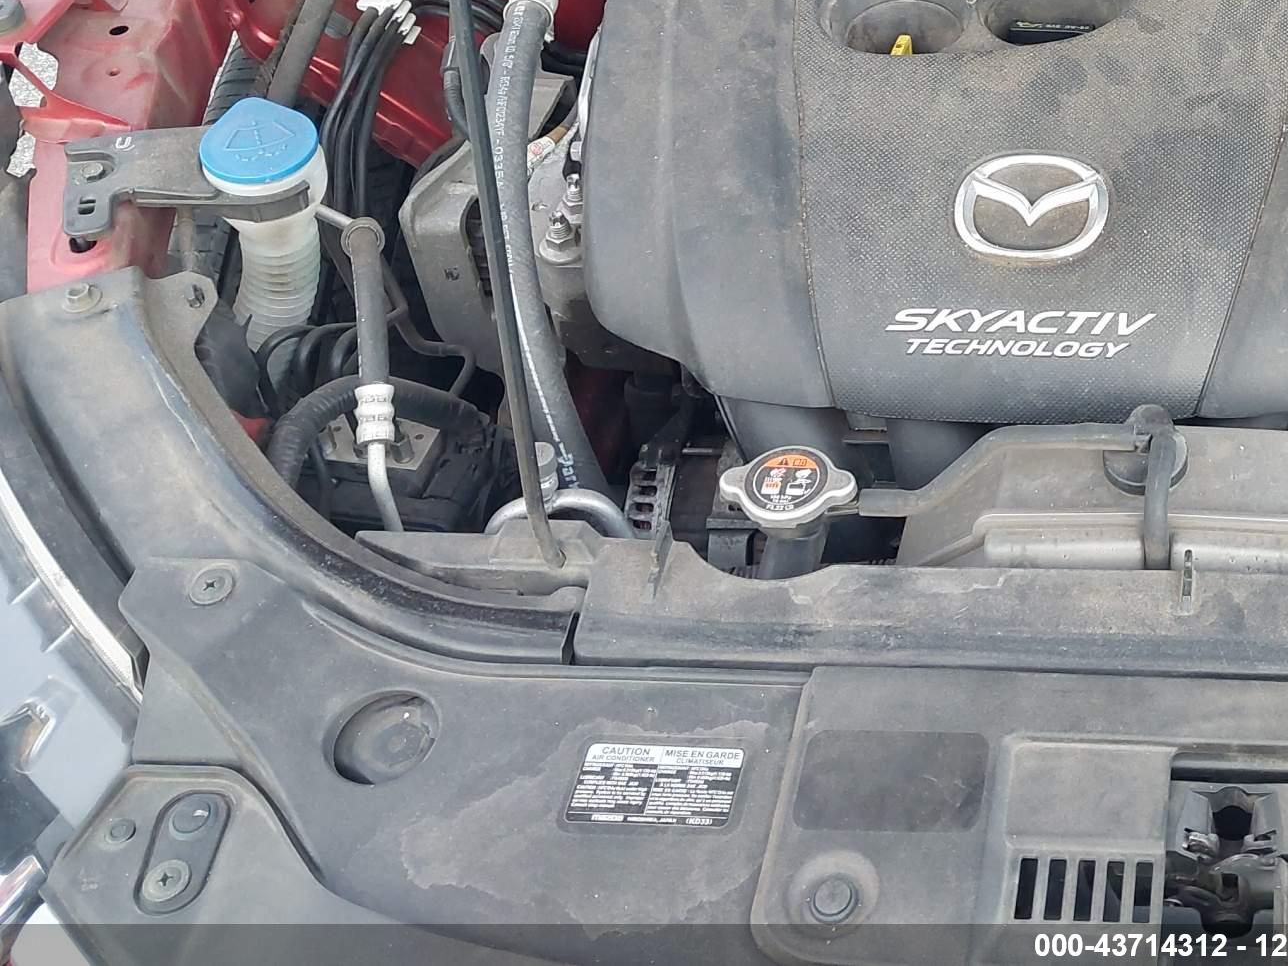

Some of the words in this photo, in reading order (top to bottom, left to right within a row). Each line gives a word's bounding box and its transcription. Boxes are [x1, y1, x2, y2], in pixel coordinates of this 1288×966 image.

[885, 308, 1158, 336] SKYACTIV
[906, 338, 1130, 359] TECHNOLOGY
[601, 746, 650, 756] CAUTION
[664, 750, 691, 758] MISE
[705, 751, 741, 760] GARDE
